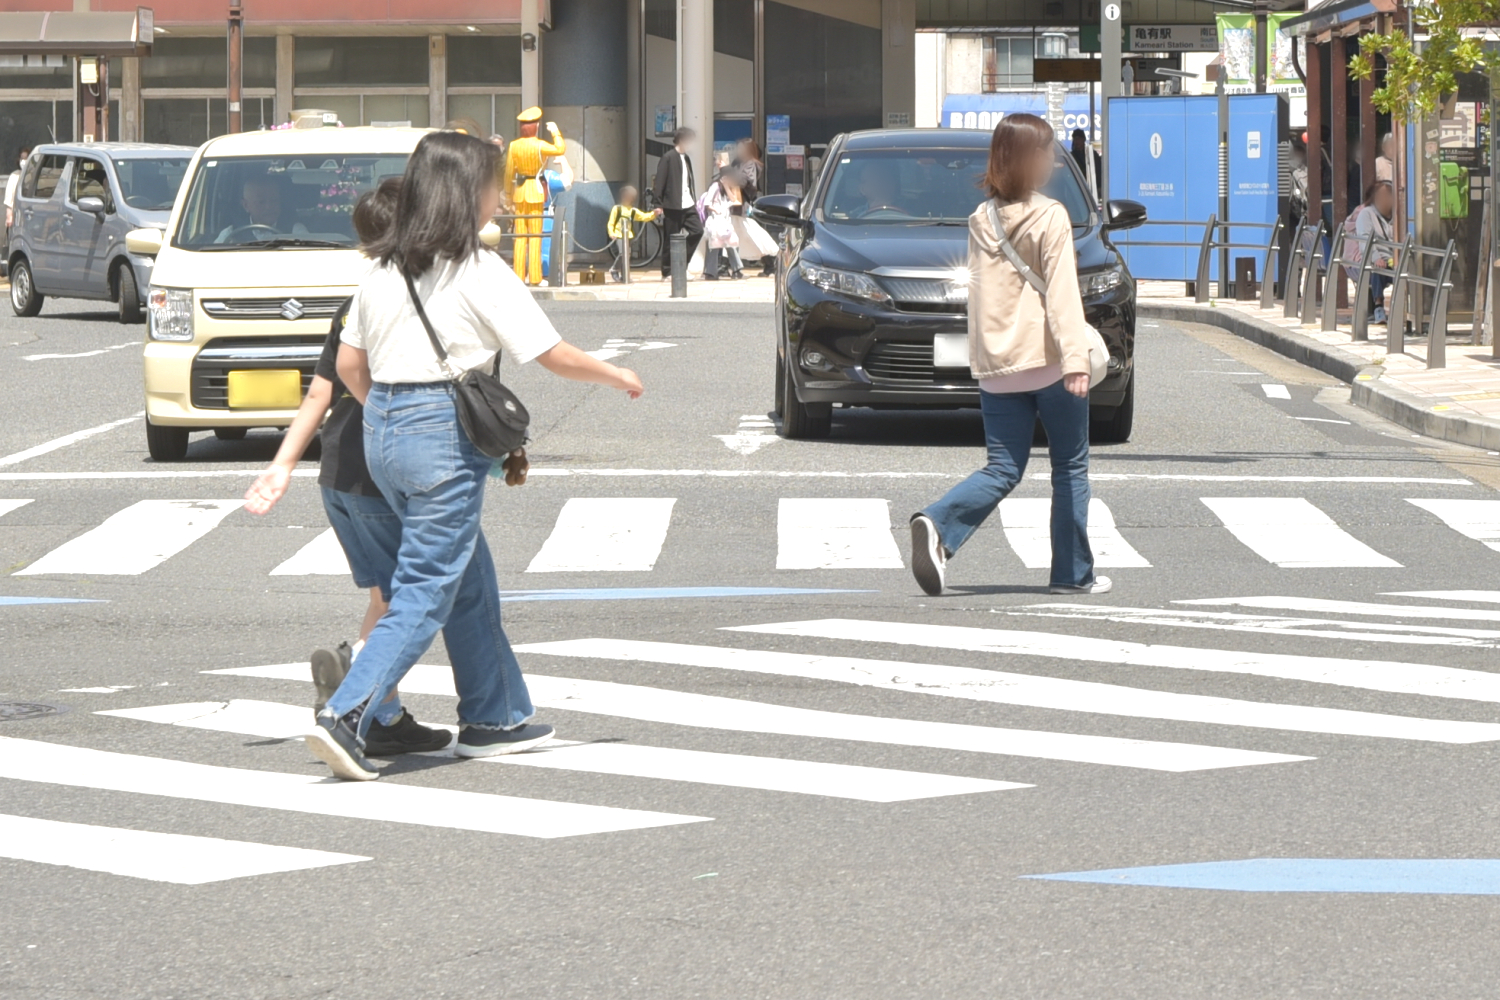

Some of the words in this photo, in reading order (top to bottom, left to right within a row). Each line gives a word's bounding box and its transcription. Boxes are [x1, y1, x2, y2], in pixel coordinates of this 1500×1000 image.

[1135, 27, 1172, 40] 亀有駅
[1200, 28, 1217, 37] 南口
[1167, 41, 1194, 49] Station
